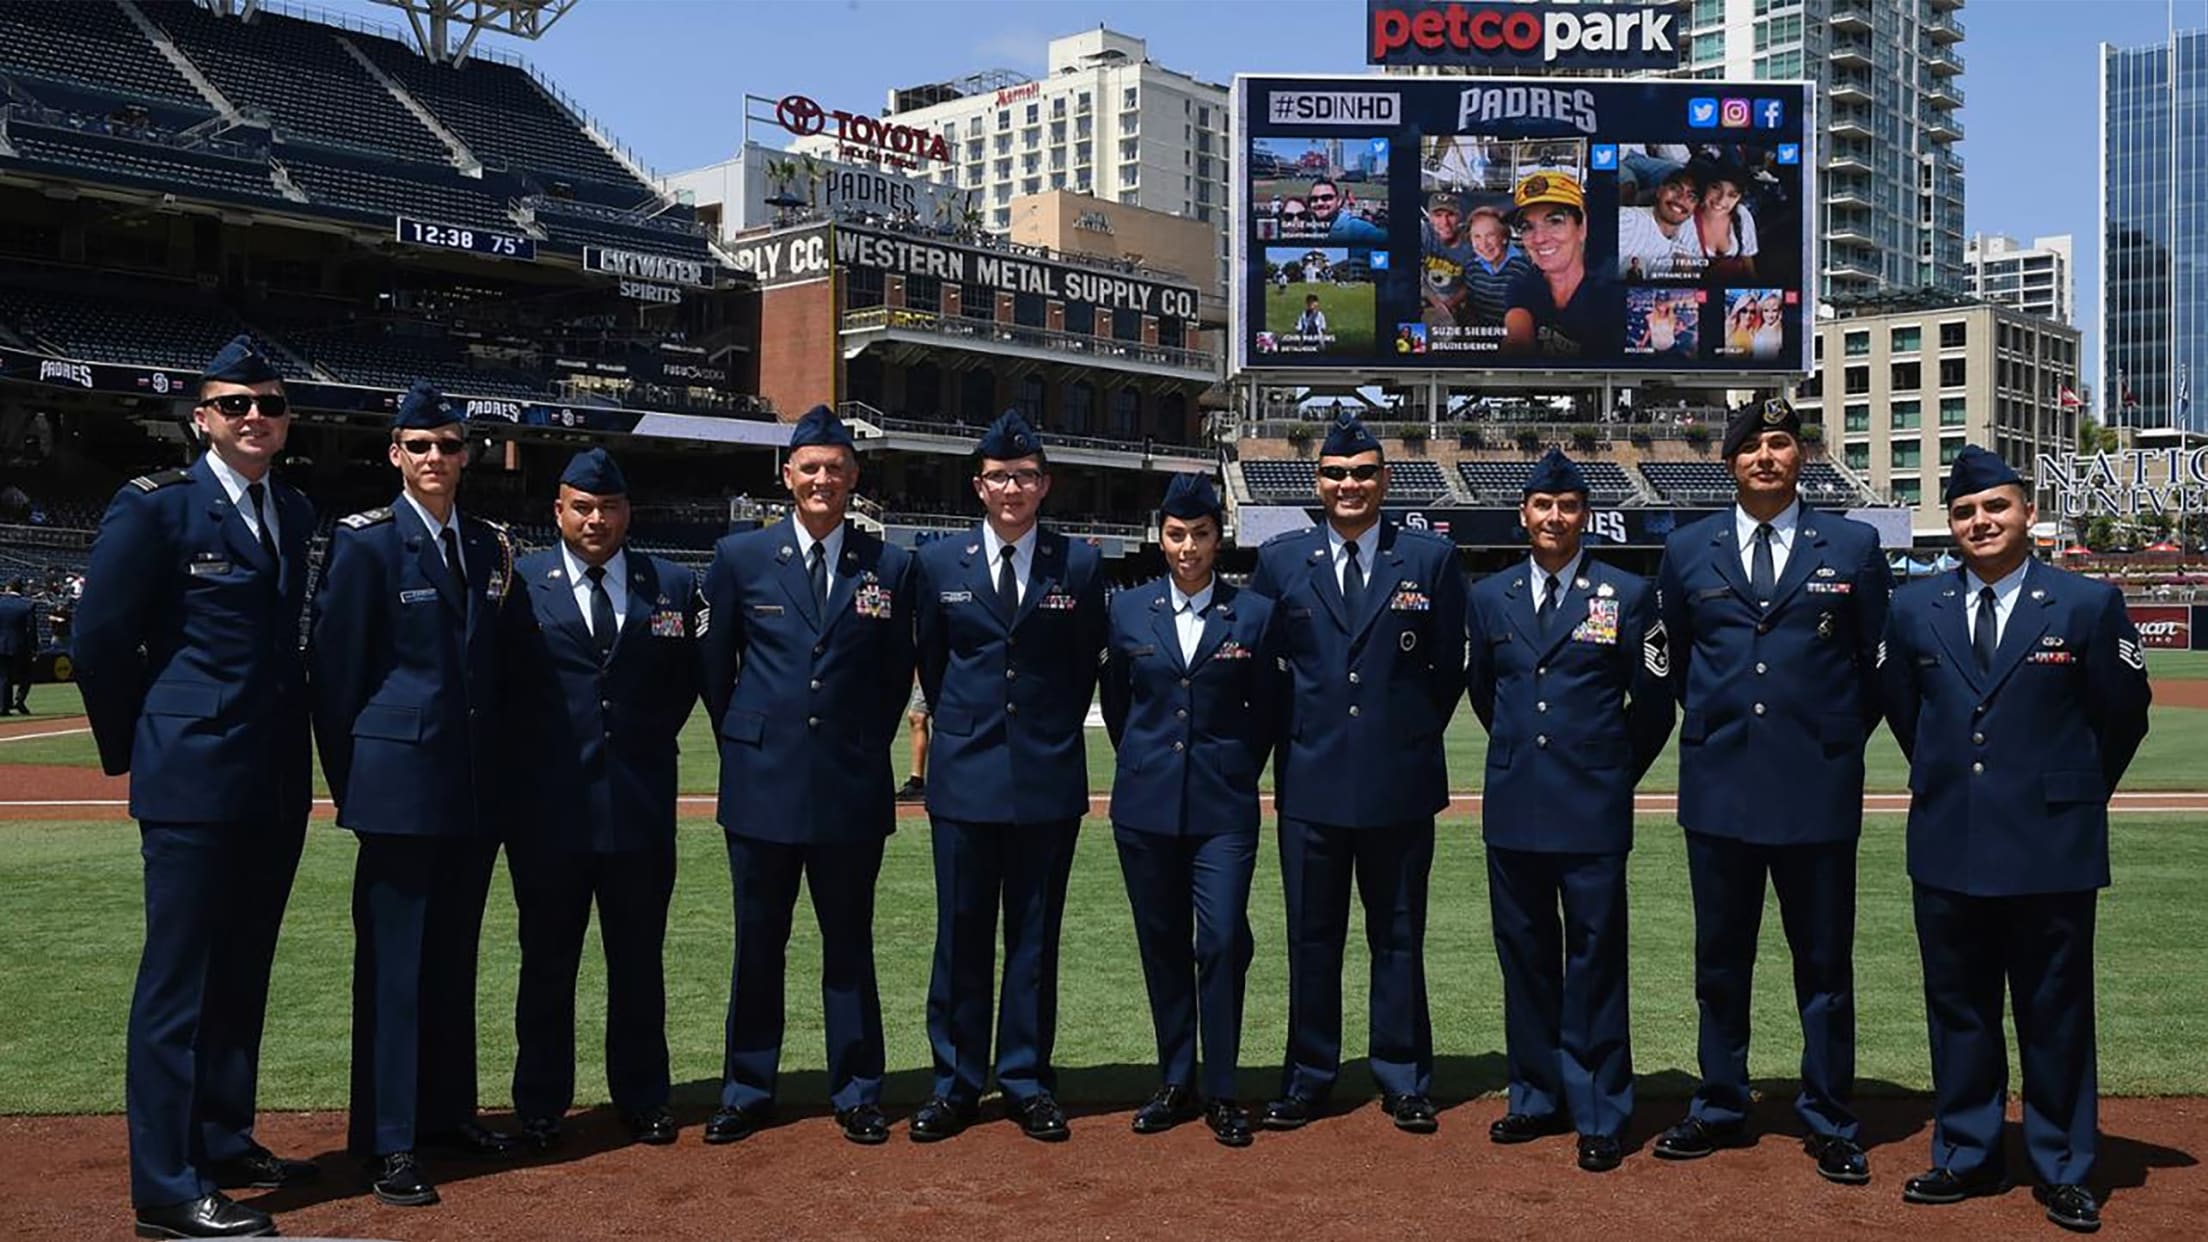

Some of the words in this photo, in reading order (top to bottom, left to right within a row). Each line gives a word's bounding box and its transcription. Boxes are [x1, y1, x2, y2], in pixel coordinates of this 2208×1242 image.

[1274, 95, 1393, 120] #SDINHD
[1457, 86, 1598, 134] PADRES
[832, 110, 950, 163] TOYOTA
[826, 168, 916, 214] PADRES
[412, 222, 474, 249] 12:38
[601, 248, 703, 285] CUTWATER
[790, 236, 830, 274] CO.
[620, 281, 682, 304] SPIRITS
[834, 230, 964, 281] WESTERN
[976, 256, 1058, 298] METAL
[1064, 272, 1153, 312] SUPPLY
[1161, 289, 1198, 319] CO.
[40, 360, 93, 388] PADRES
[466, 400, 520, 423] PADRES
